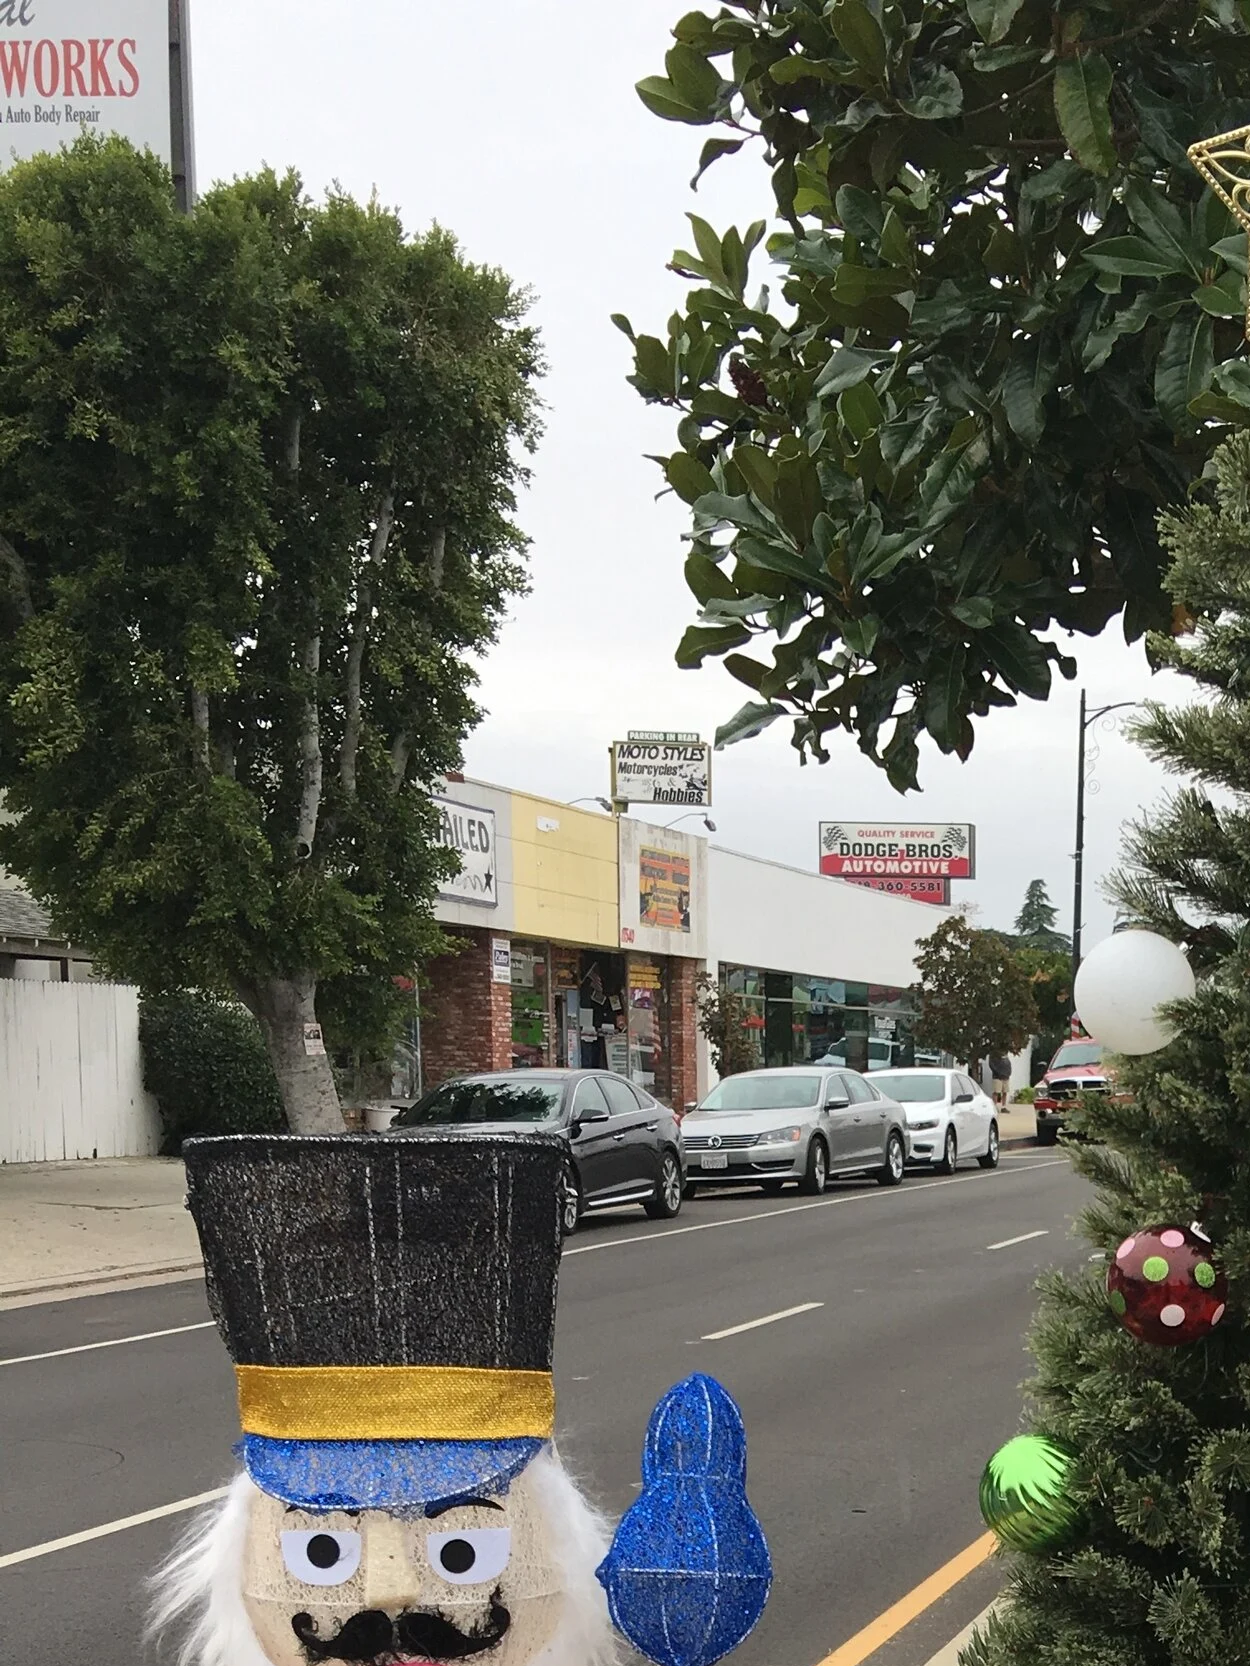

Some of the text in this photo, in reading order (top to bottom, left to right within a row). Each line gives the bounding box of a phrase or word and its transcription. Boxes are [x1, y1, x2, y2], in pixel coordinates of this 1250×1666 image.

[0, 38, 139, 98] WORKS
[6, 105, 31, 123] Auto
[34, 104, 61, 126] Body
[65, 104, 101, 123] Repair
[629, 732, 698, 742] PARKING IN REAR
[618, 745, 706, 762] MOTO STYLES
[618, 762, 678, 777] Motorcycles
[653, 787, 704, 804] Hobbies
[857, 829, 935, 839] QUALITY SERVICE
[839, 843, 959, 859] DODGE BROS.
[841, 860, 950, 874] AUTOMOTIVE
